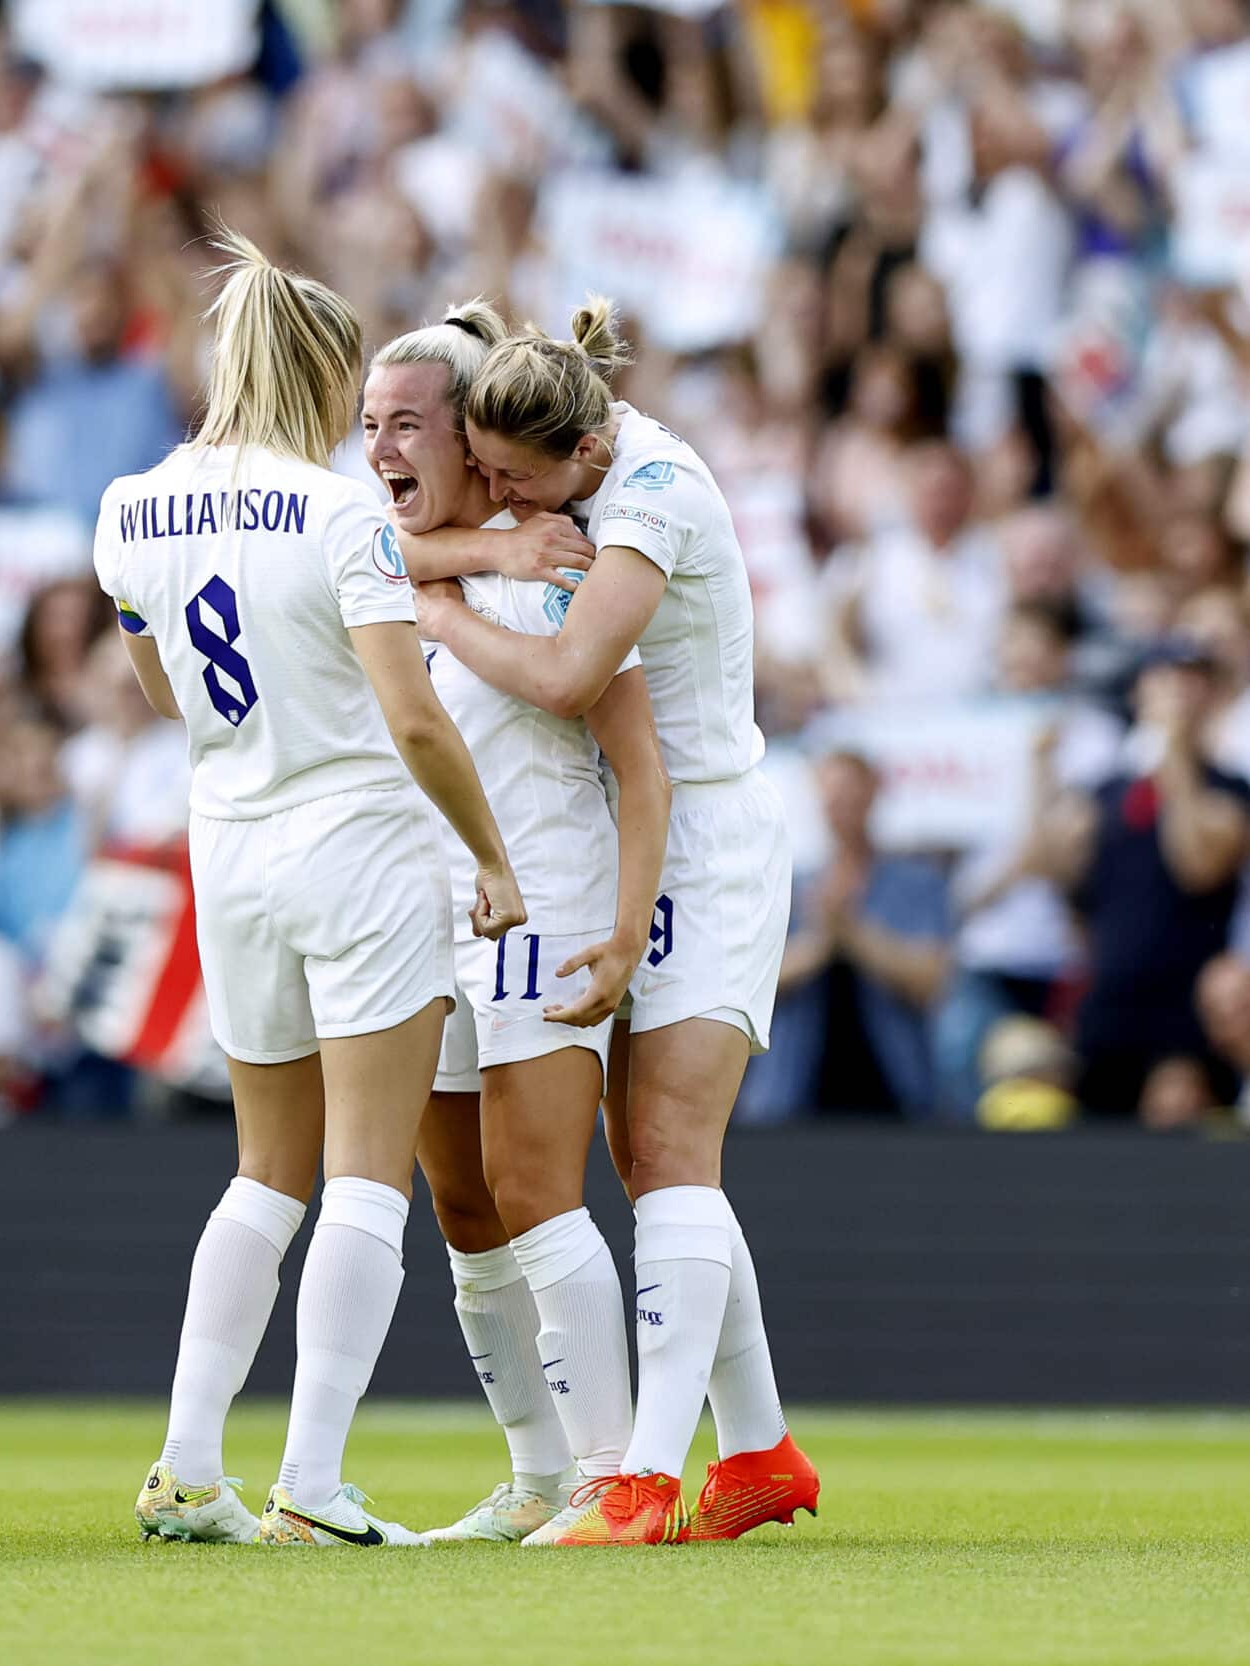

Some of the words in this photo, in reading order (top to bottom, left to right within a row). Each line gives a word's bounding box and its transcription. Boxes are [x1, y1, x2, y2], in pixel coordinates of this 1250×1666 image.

[120, 489, 309, 544] WILLIAMSON
[185, 574, 259, 728] 8
[647, 894, 674, 967] 9
[492, 934, 543, 1001] 11
[636, 1308, 664, 1326] ng
[547, 1380, 570, 1394] ng
